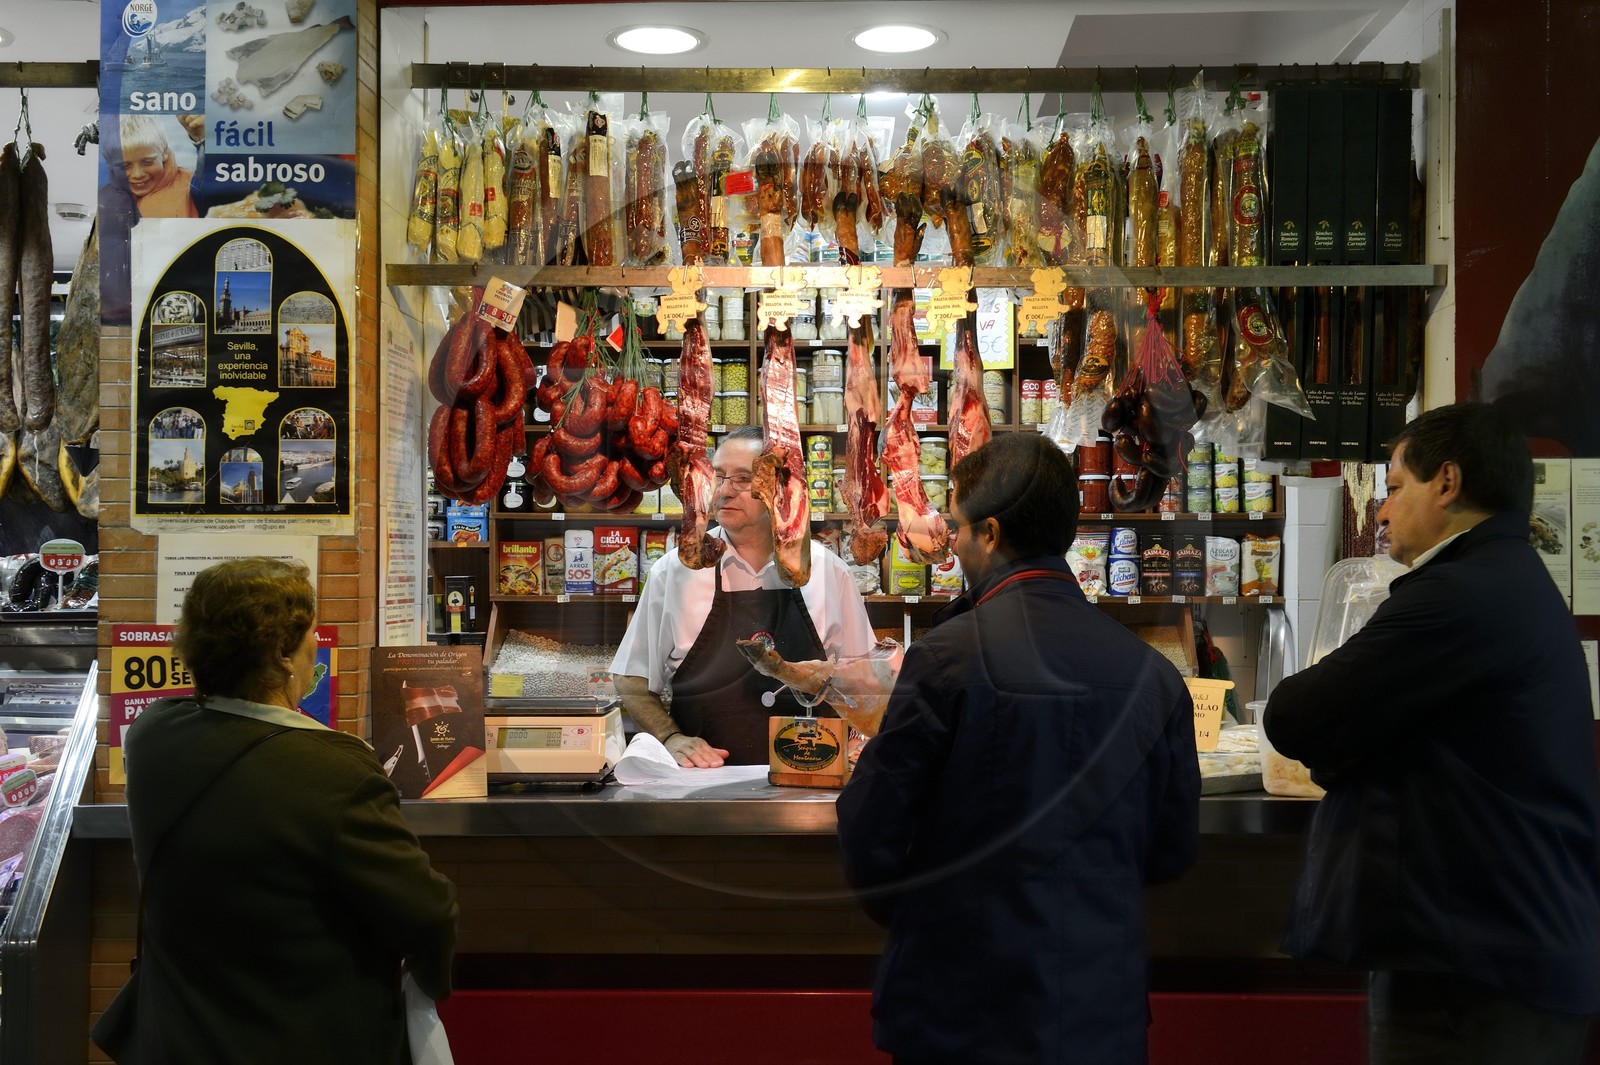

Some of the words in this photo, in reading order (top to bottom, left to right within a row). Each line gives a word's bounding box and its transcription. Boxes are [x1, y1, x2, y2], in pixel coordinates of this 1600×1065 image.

[130, 4, 152, 12] NORGE
[130, 91, 196, 111] sano
[214, 120, 274, 147] fácil
[214, 156, 325, 182] sabroso
[502, 312, 512, 322] 90
[227, 342, 258, 351] Sevilla,
[218, 362, 268, 371] experiencia
[220, 371, 266, 380] inolvidable
[503, 544, 537, 553] brillante
[568, 569, 591, 579] SOS
[120, 632, 176, 642] SOBRASA
[124, 655, 167, 690] 80
[1194, 704, 1219, 712] ALAO
